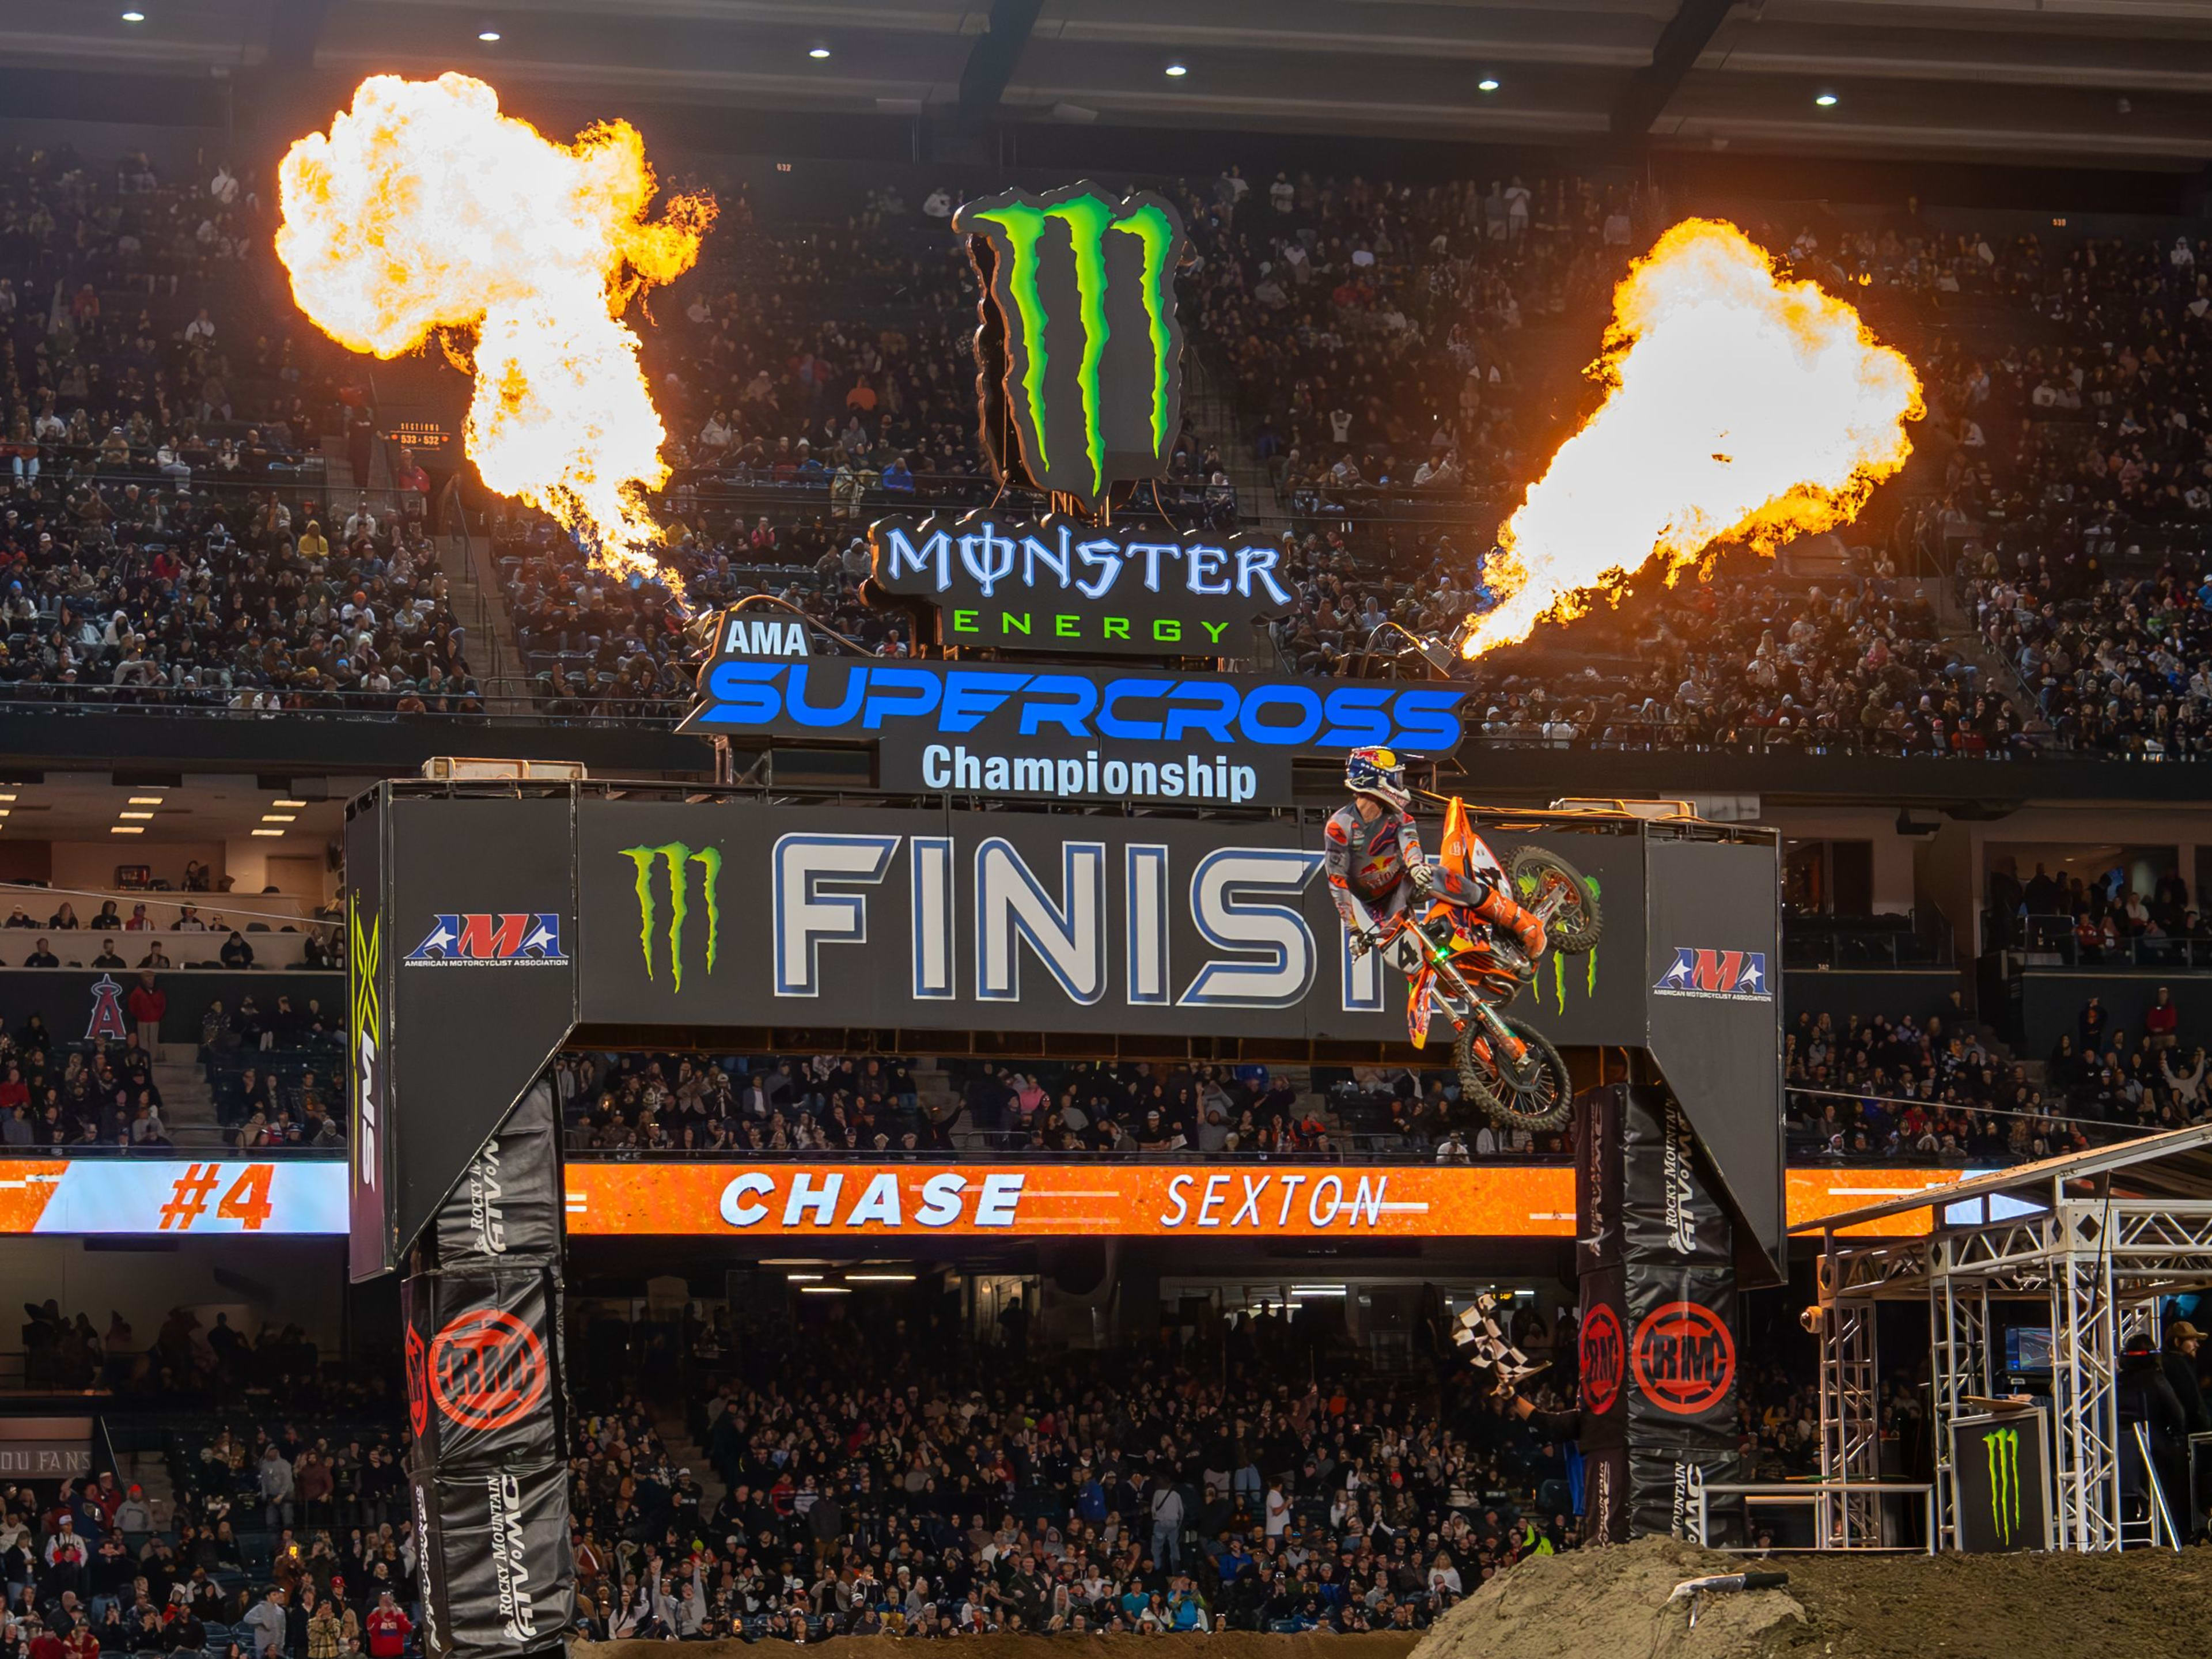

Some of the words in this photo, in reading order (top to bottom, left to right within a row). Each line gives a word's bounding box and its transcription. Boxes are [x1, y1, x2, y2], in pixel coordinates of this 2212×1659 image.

[885, 522, 1291, 605] MONSTER
[725, 620, 808, 656] AMA
[954, 609, 1229, 643] ENERGY
[699, 661, 1467, 750] SUPERCROSS
[922, 745, 1257, 803] Championship
[403, 914, 570, 959] AMA
[1397, 935, 1419, 970] 4
[1652, 947, 1772, 995] AMA
[1686, 991, 1732, 999] MOTORCYCLIST
[1732, 994, 1772, 1002] ASSOCIATION
[1664, 1098, 1677, 1178] MOUNTAIN
[158, 1164, 275, 1230] #4
[470, 1178, 484, 1231] ROCKY
[719, 1172, 1025, 1227] CHASE
[1160, 1174, 1388, 1228] SEXTON
[1665, 1180, 1678, 1230] ROCKY
[1653, 1334, 1715, 1382] RM
[39, 1450, 91, 1471] FANS
[487, 1475, 507, 1562] MOUNTAIN
[497, 1563, 513, 1617] ROCKY
